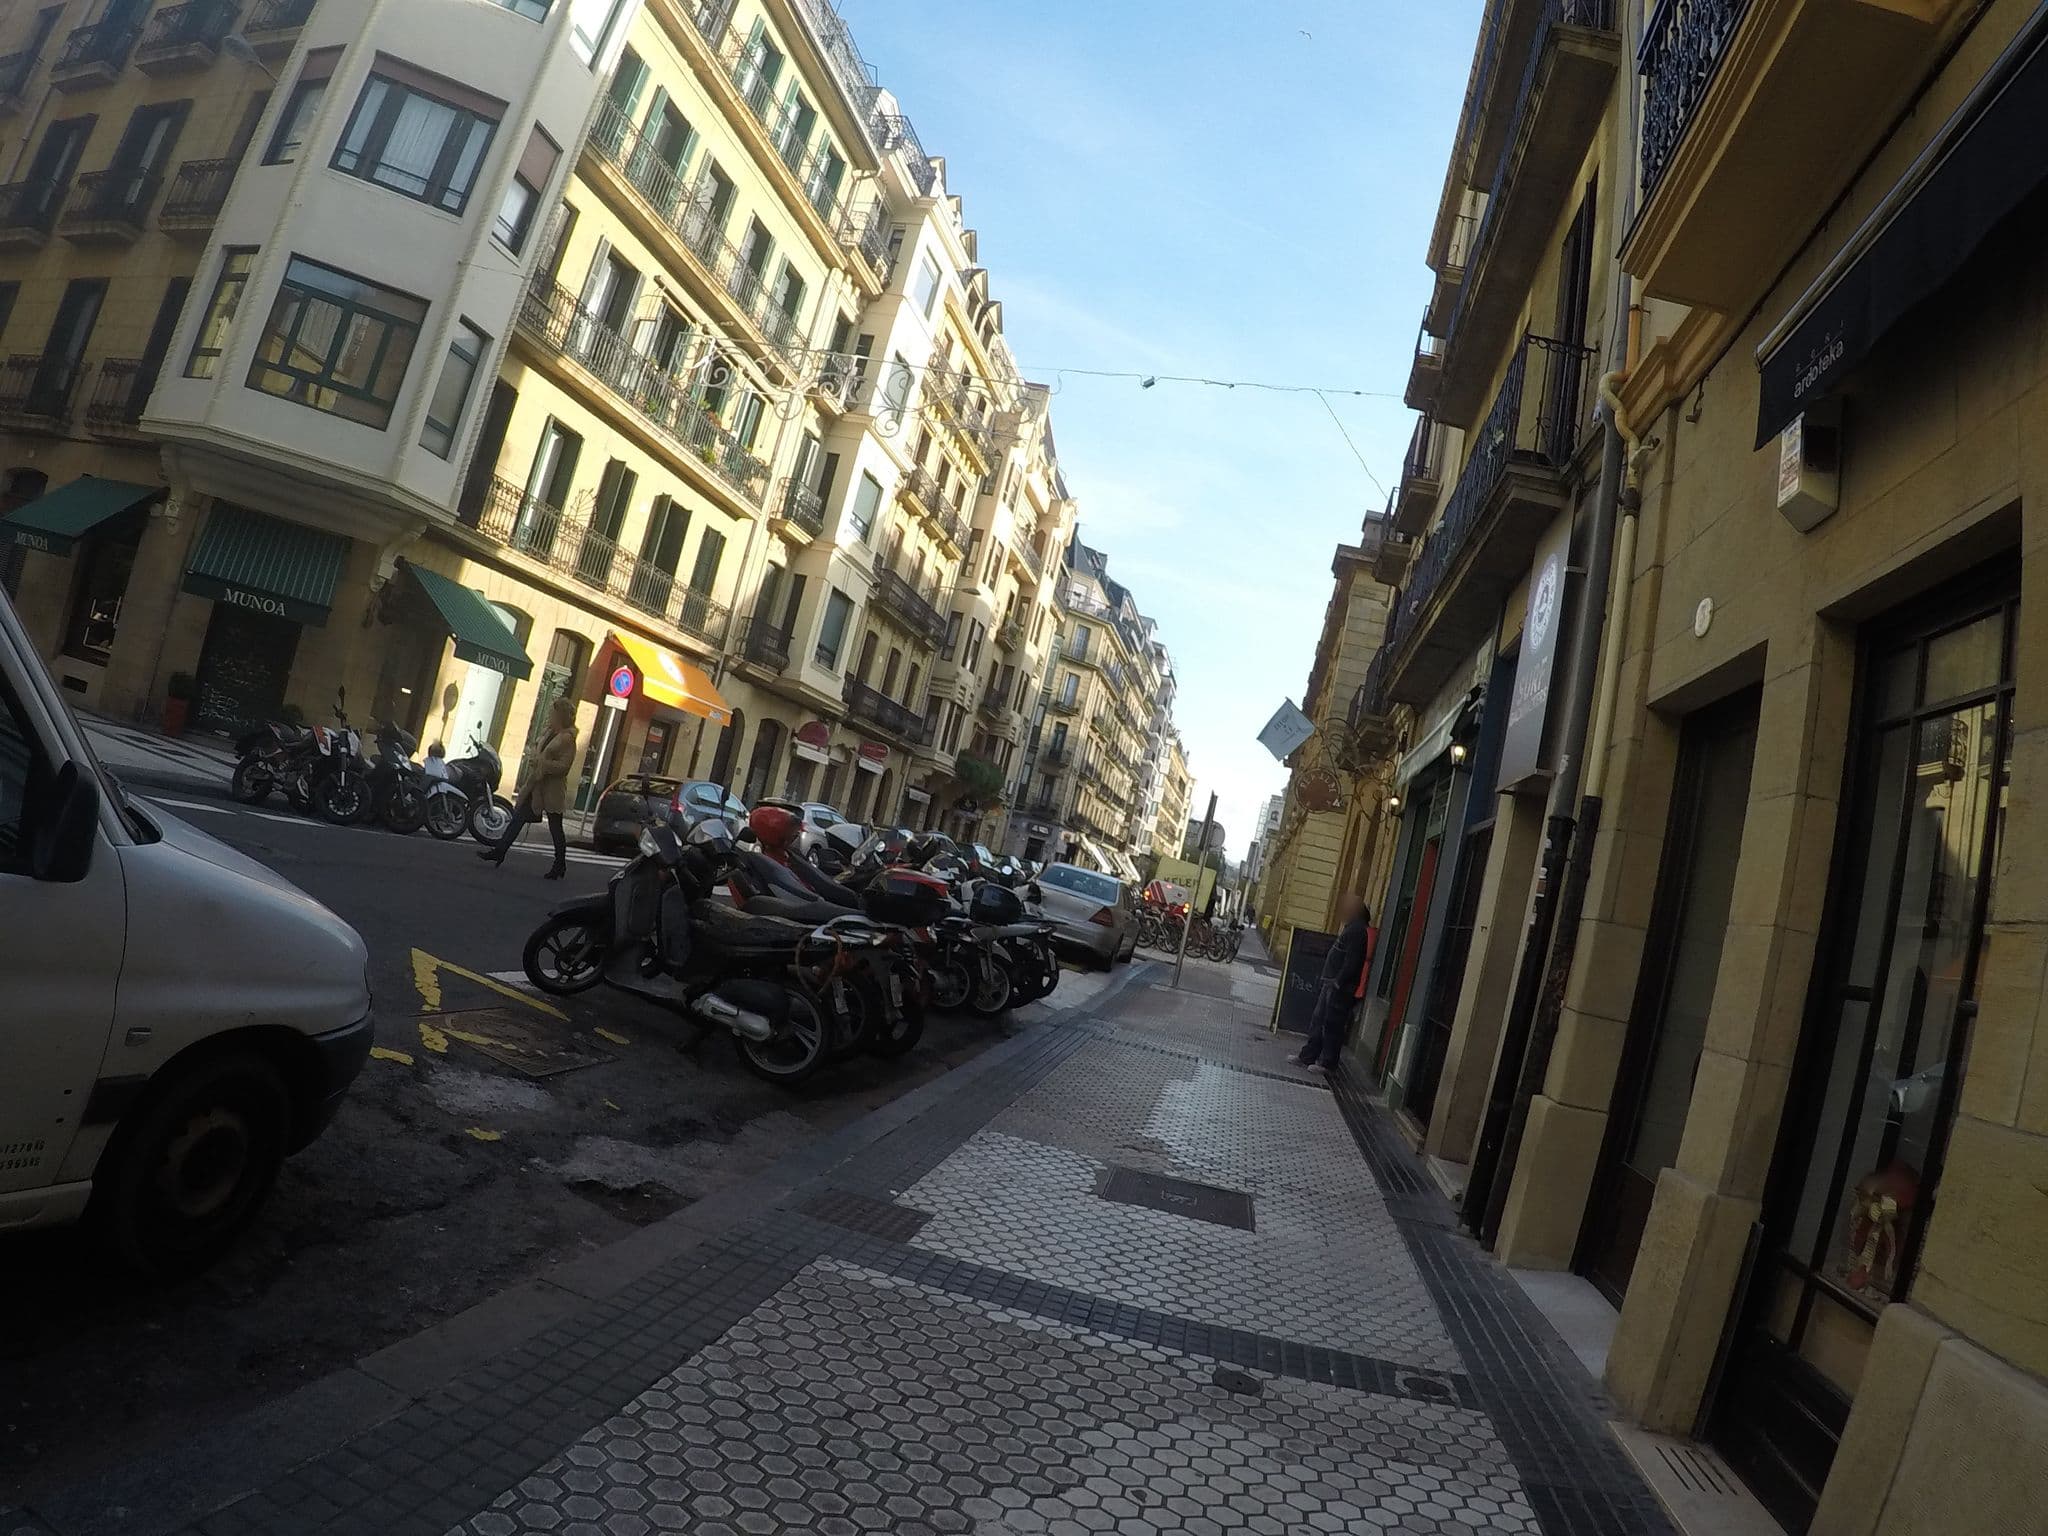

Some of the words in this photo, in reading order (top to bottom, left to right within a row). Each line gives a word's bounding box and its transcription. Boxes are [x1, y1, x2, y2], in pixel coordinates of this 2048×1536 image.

[1794, 340, 1844, 398] ardoteka
[15, 531, 48, 551] MUNOA
[223, 588, 286, 617] MUNOA
[475, 651, 510, 674] MUNOA
